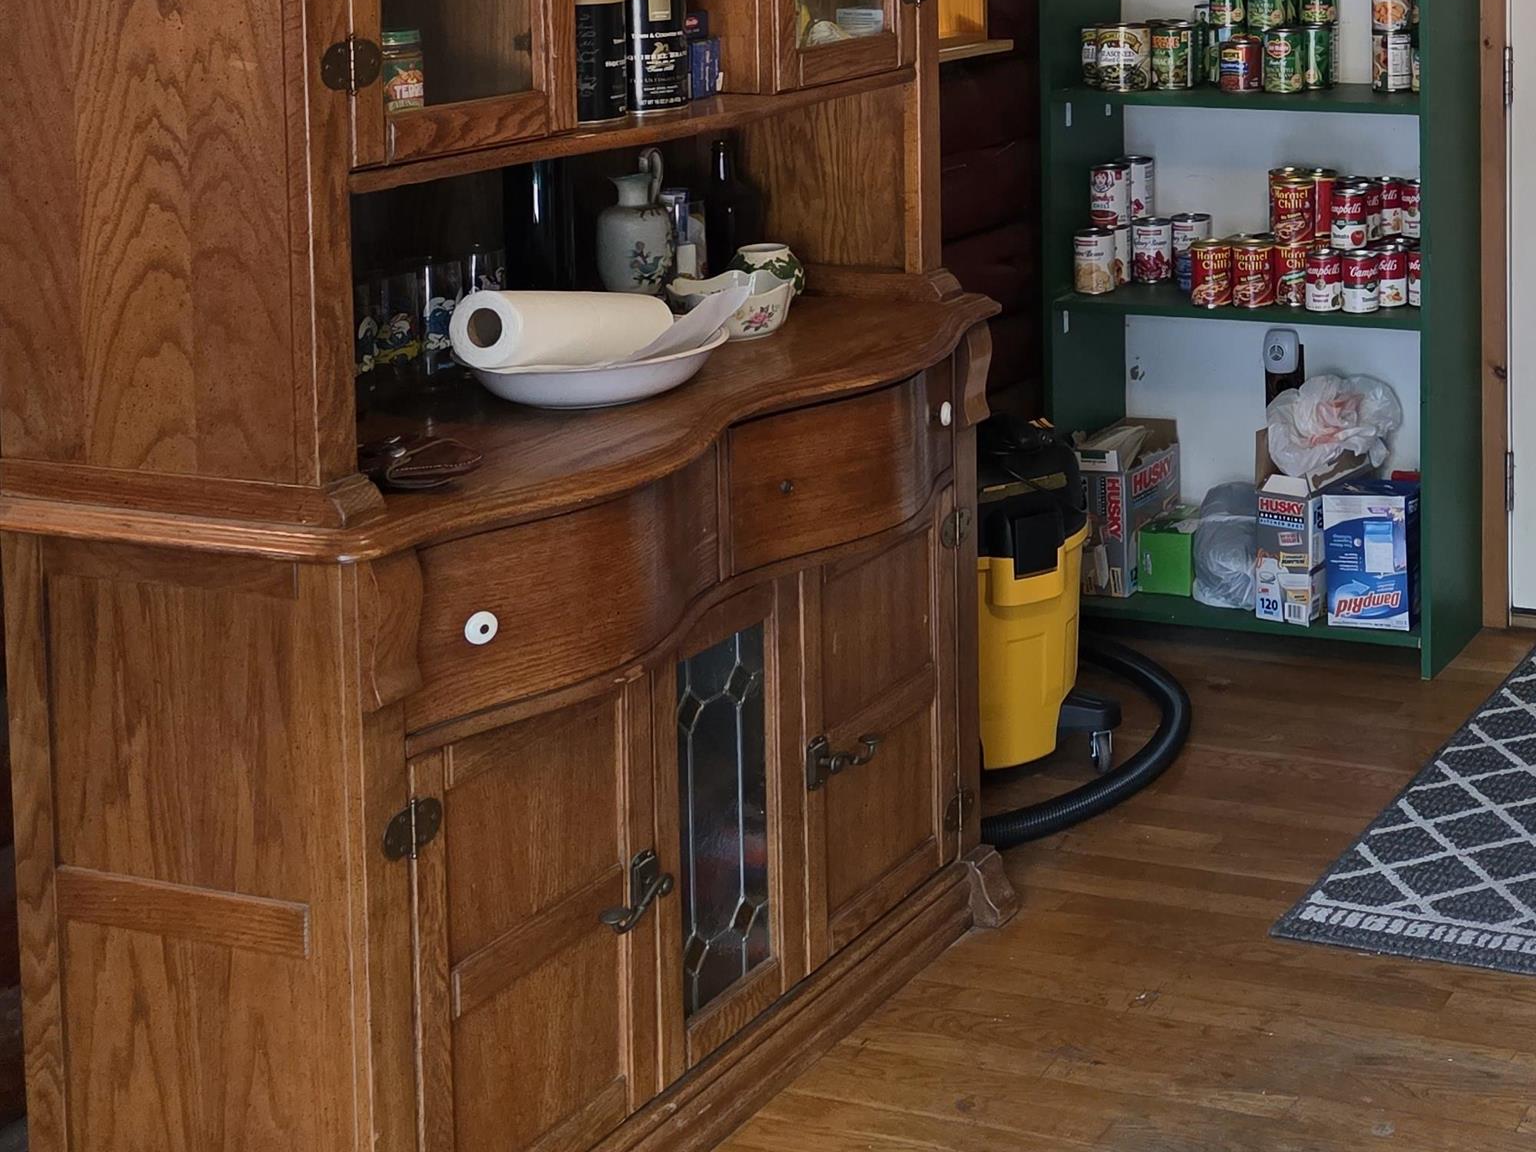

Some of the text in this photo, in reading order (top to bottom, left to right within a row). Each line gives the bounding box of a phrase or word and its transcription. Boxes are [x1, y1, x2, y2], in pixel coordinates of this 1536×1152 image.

[1275, 188, 1308, 199] Hormel
[1278, 199, 1302, 208] Chili
[1331, 203, 1361, 215] ampbell's
[1233, 251, 1268, 261] Hormel
[1202, 260, 1227, 270] Chili
[1237, 261, 1262, 271] Chili
[1131, 455, 1174, 497] HUSKY
[1105, 476, 1124, 543] HUSKY
[1258, 496, 1306, 517] HUSKY
[1259, 597, 1279, 611] 120
[1335, 589, 1400, 618] DampRid
